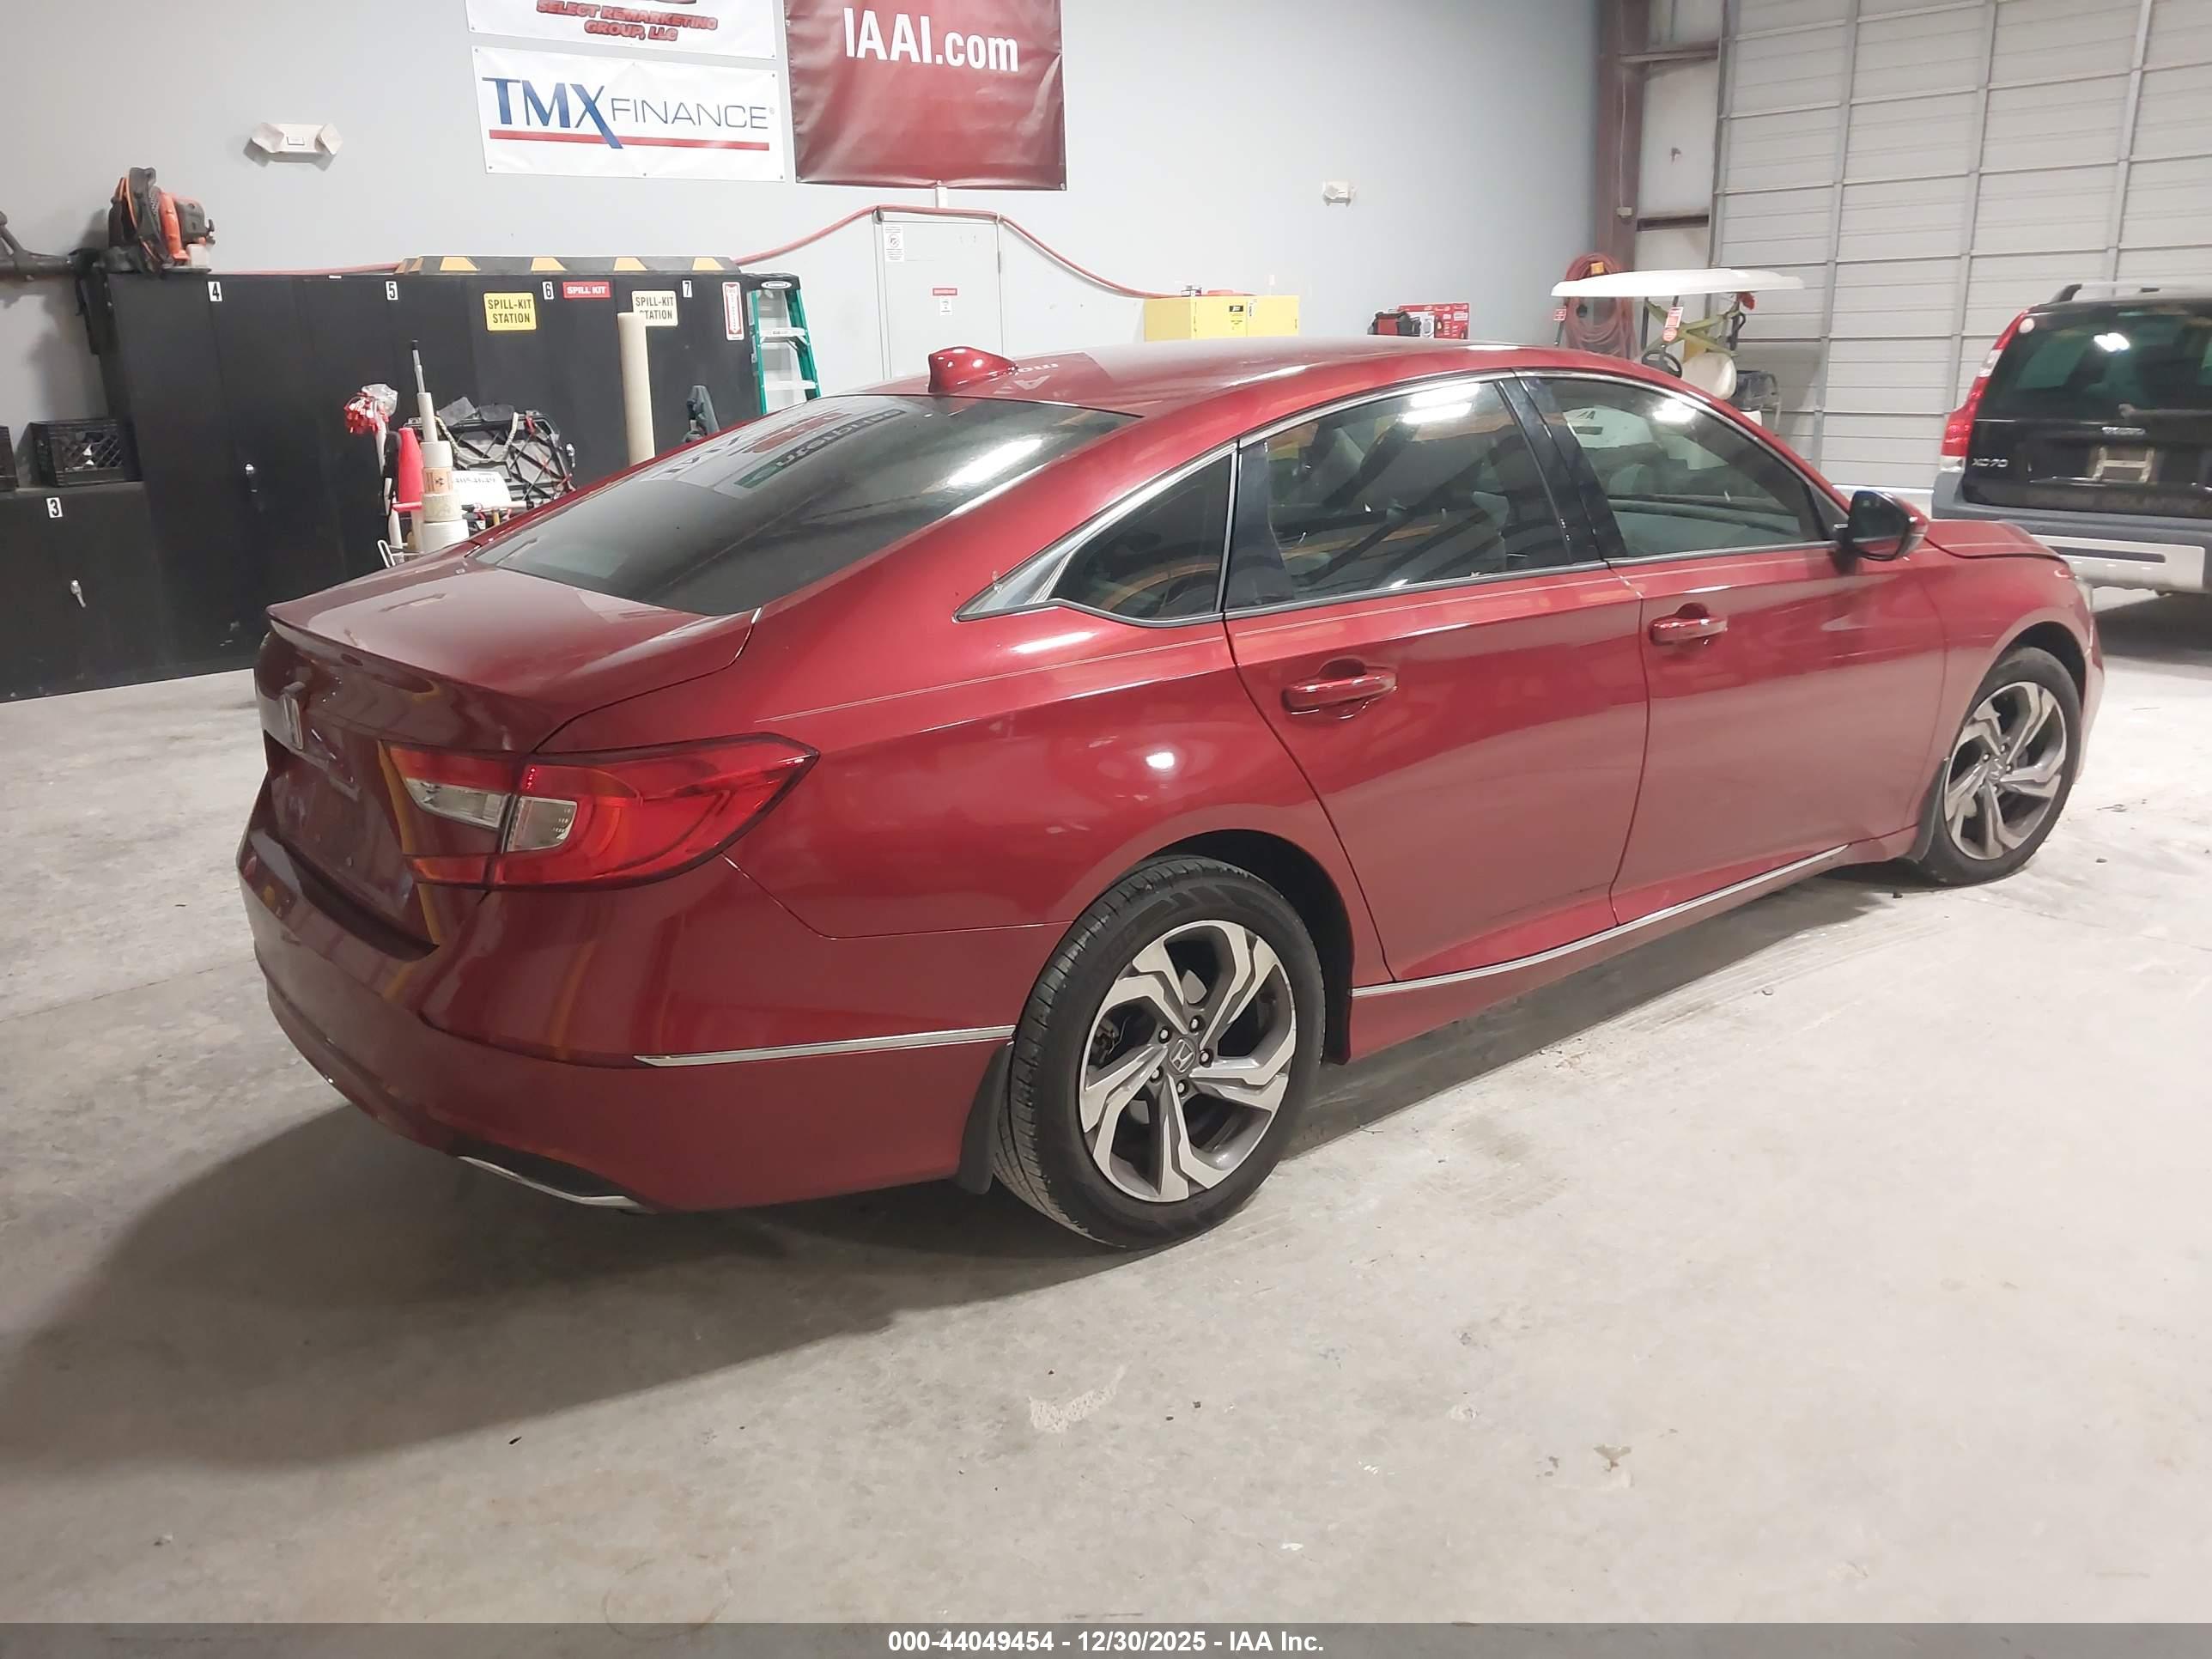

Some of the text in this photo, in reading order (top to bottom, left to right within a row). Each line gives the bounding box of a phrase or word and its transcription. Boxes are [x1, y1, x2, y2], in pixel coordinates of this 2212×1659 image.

[537, 0, 719, 30] SELECT REMARKETING
[584, 20, 678, 42] GROUP, LLC
[843, 7, 1019, 72] IAAI.com
[211, 282, 220, 301] 4
[388, 283, 397, 300] 5
[545, 283, 552, 298] 6
[567, 286, 607, 295] SPILL KIT
[488, 298, 532, 310] SPILL-KIT
[635, 296, 674, 307] SPILL-KIT
[492, 313, 531, 324] STATION
[50, 499, 60, 517] 3
